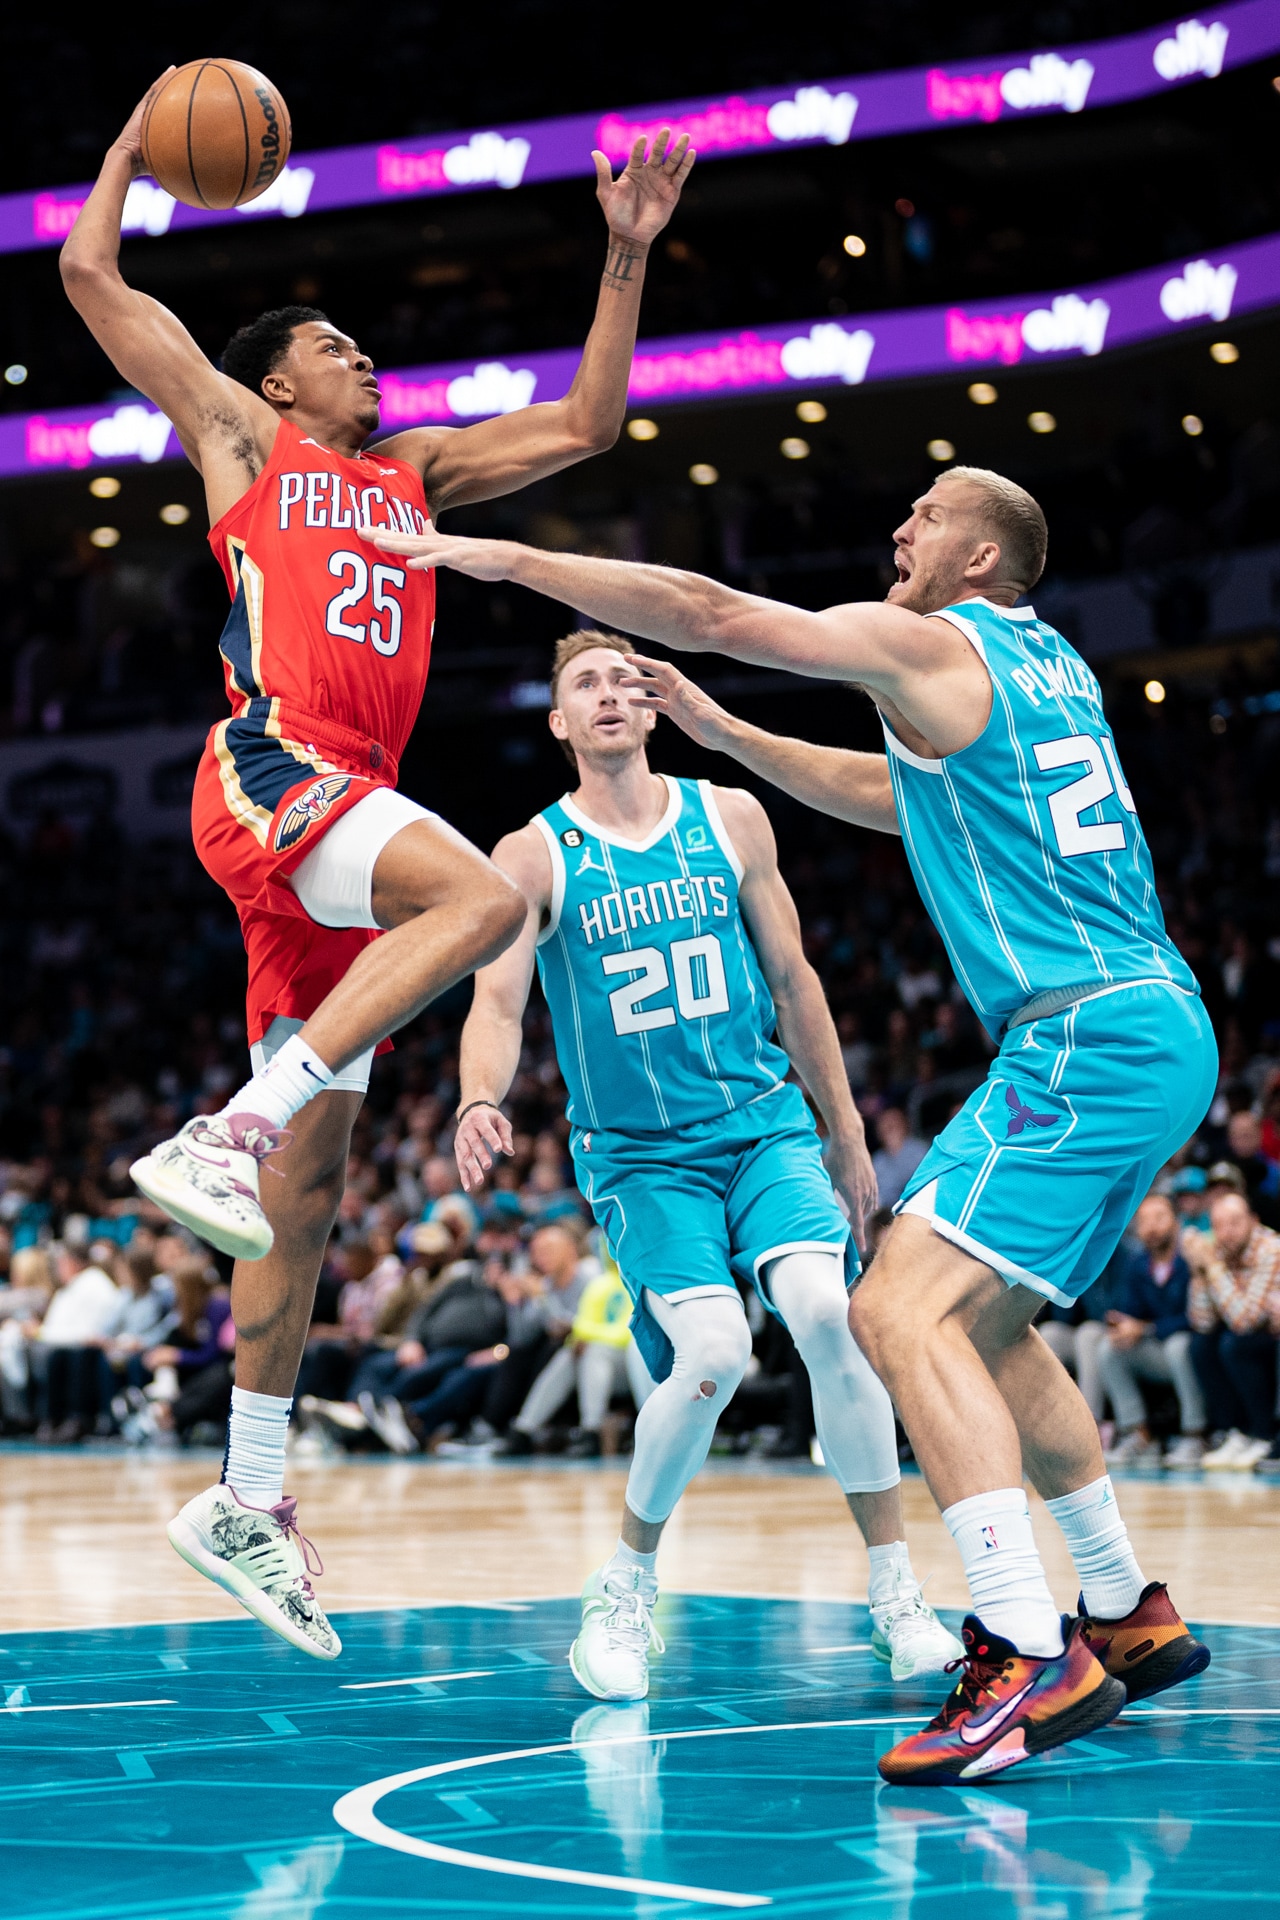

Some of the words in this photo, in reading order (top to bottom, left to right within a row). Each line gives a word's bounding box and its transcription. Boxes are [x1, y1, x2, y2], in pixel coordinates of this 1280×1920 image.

[252, 88, 280, 188] Wilson
[326, 549, 406, 658] 25
[564, 830, 580, 847] 6
[578, 876, 729, 945] HORNETS
[601, 933, 731, 1036] 20
